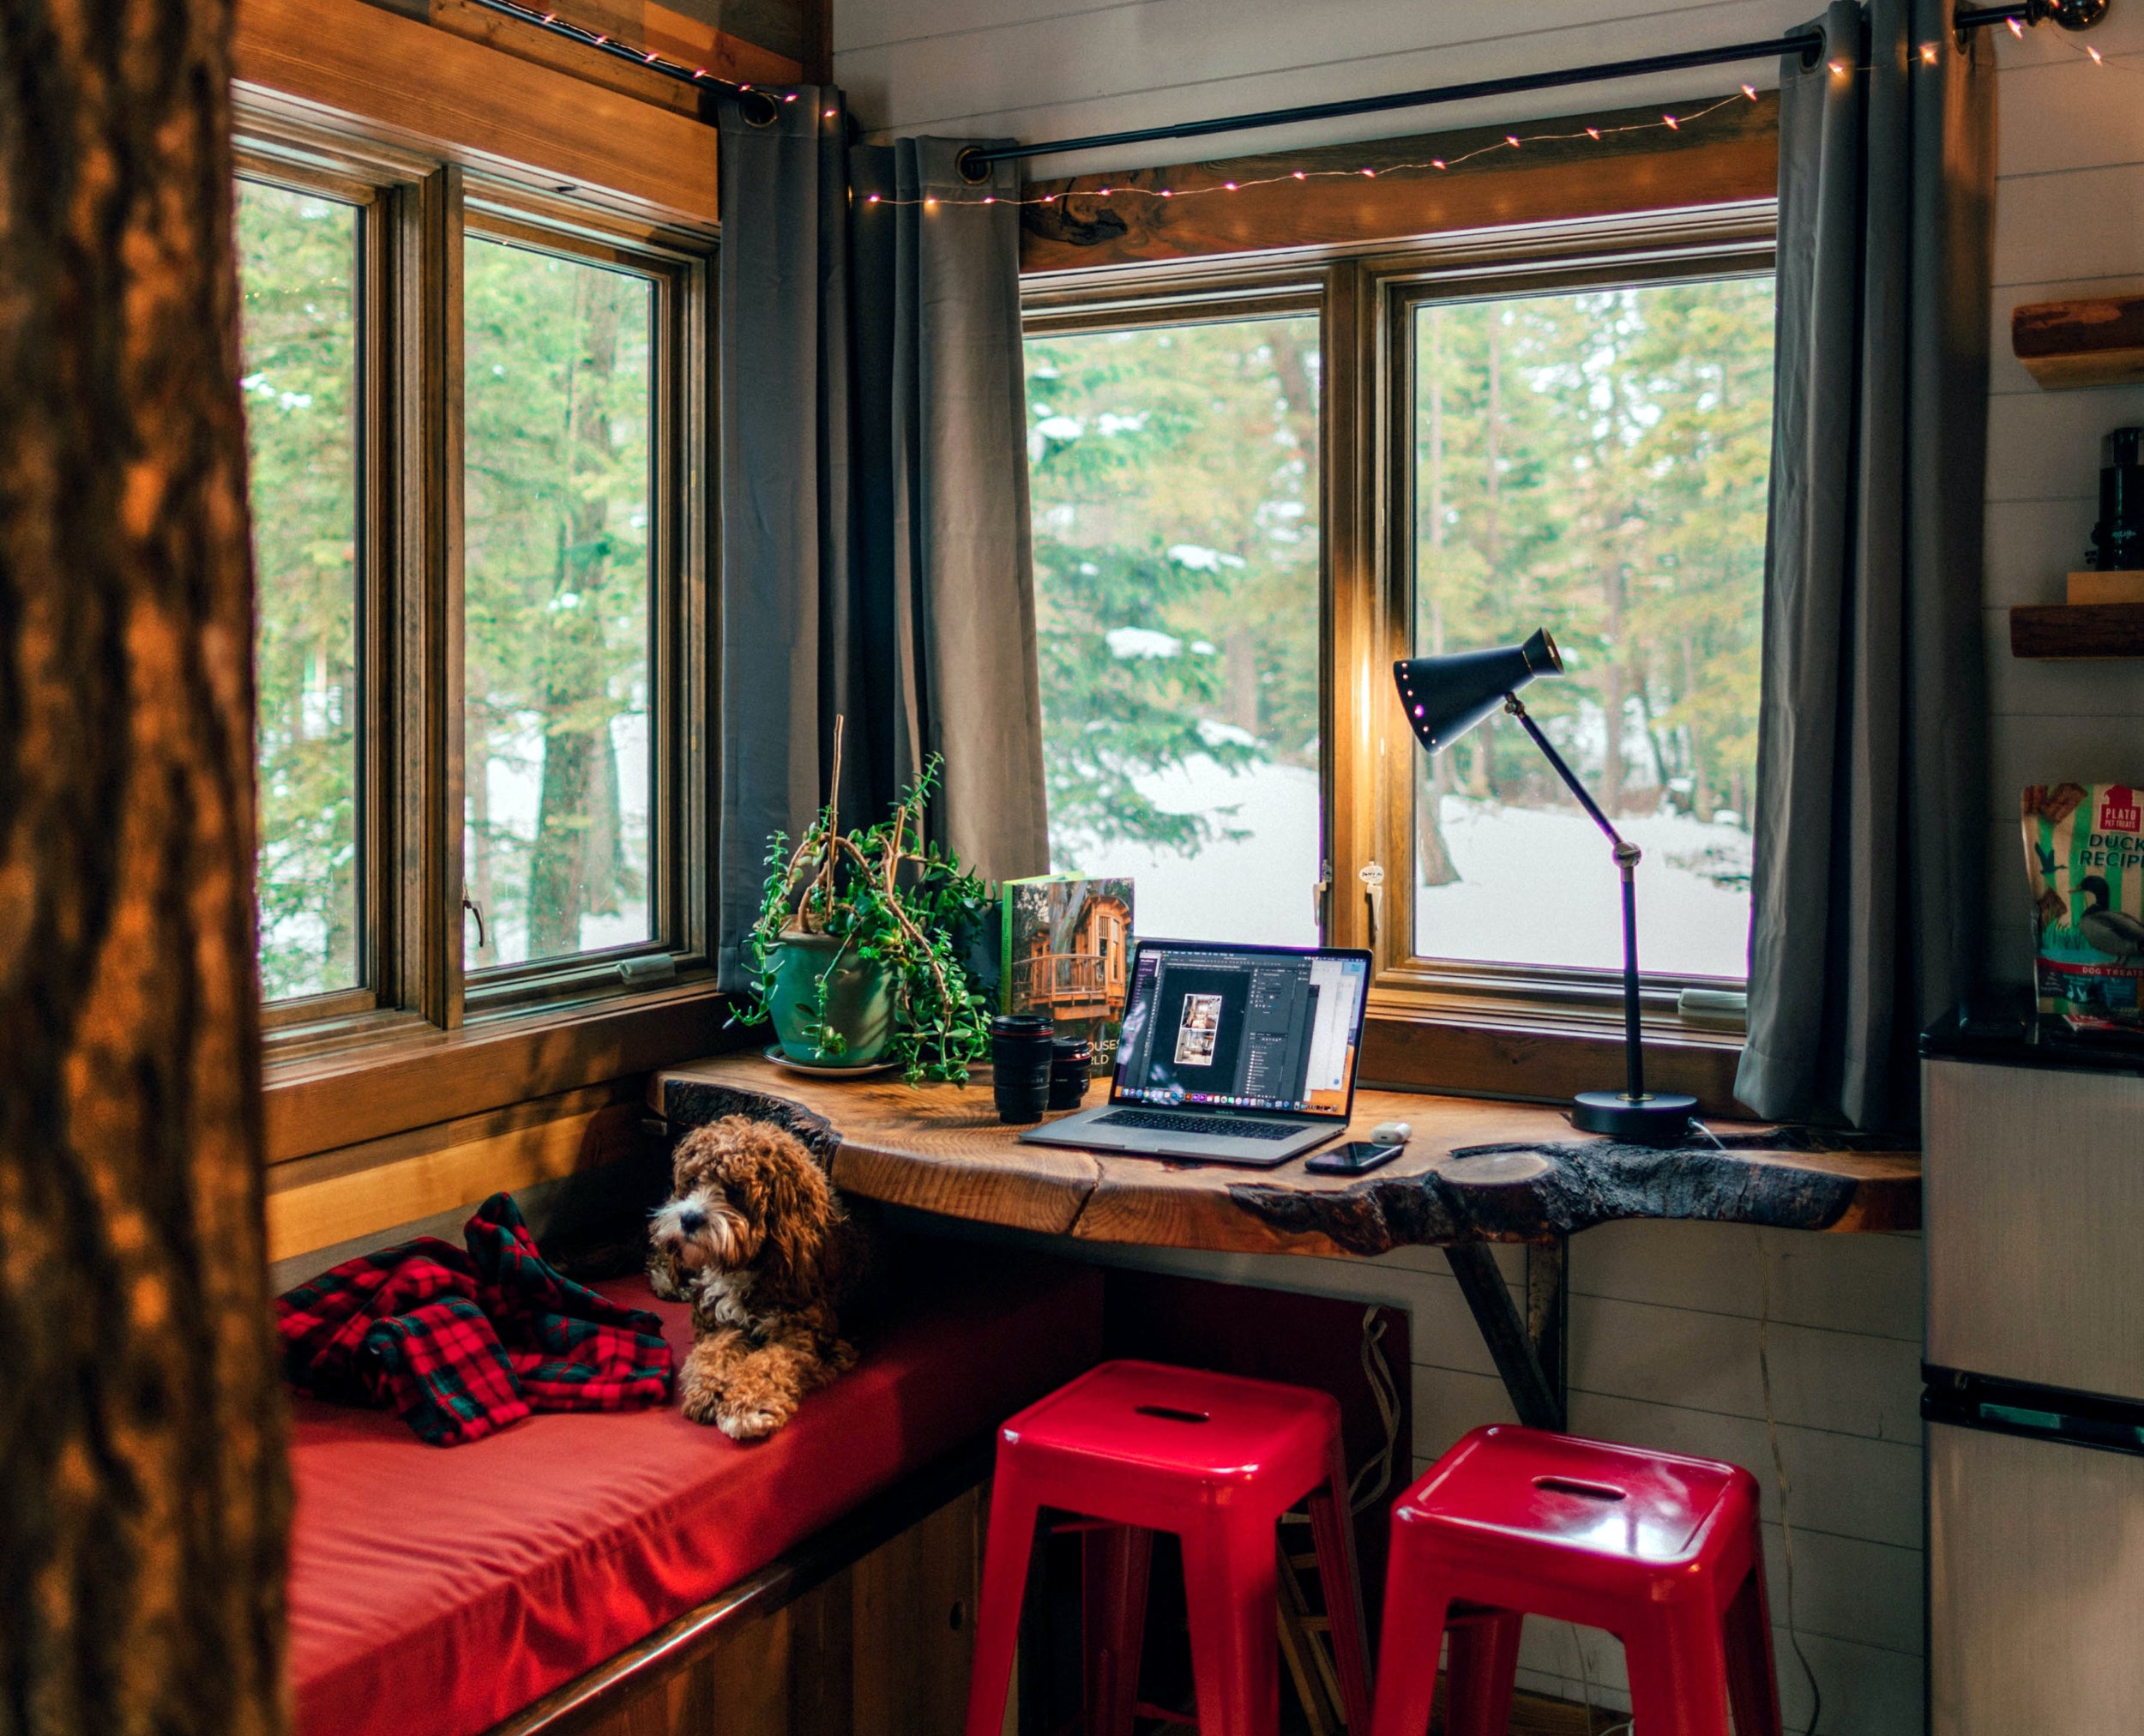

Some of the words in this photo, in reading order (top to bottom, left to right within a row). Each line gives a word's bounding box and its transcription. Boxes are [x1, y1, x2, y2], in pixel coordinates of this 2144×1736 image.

[2105, 808, 2136, 821] PLATO
[2105, 818, 2115, 827] PET
[2116, 819, 2135, 829] TREATS
[2089, 834, 2144, 851] DUCK
[2082, 967, 2101, 975] DOG
[2106, 967, 2144, 977] TREATS
